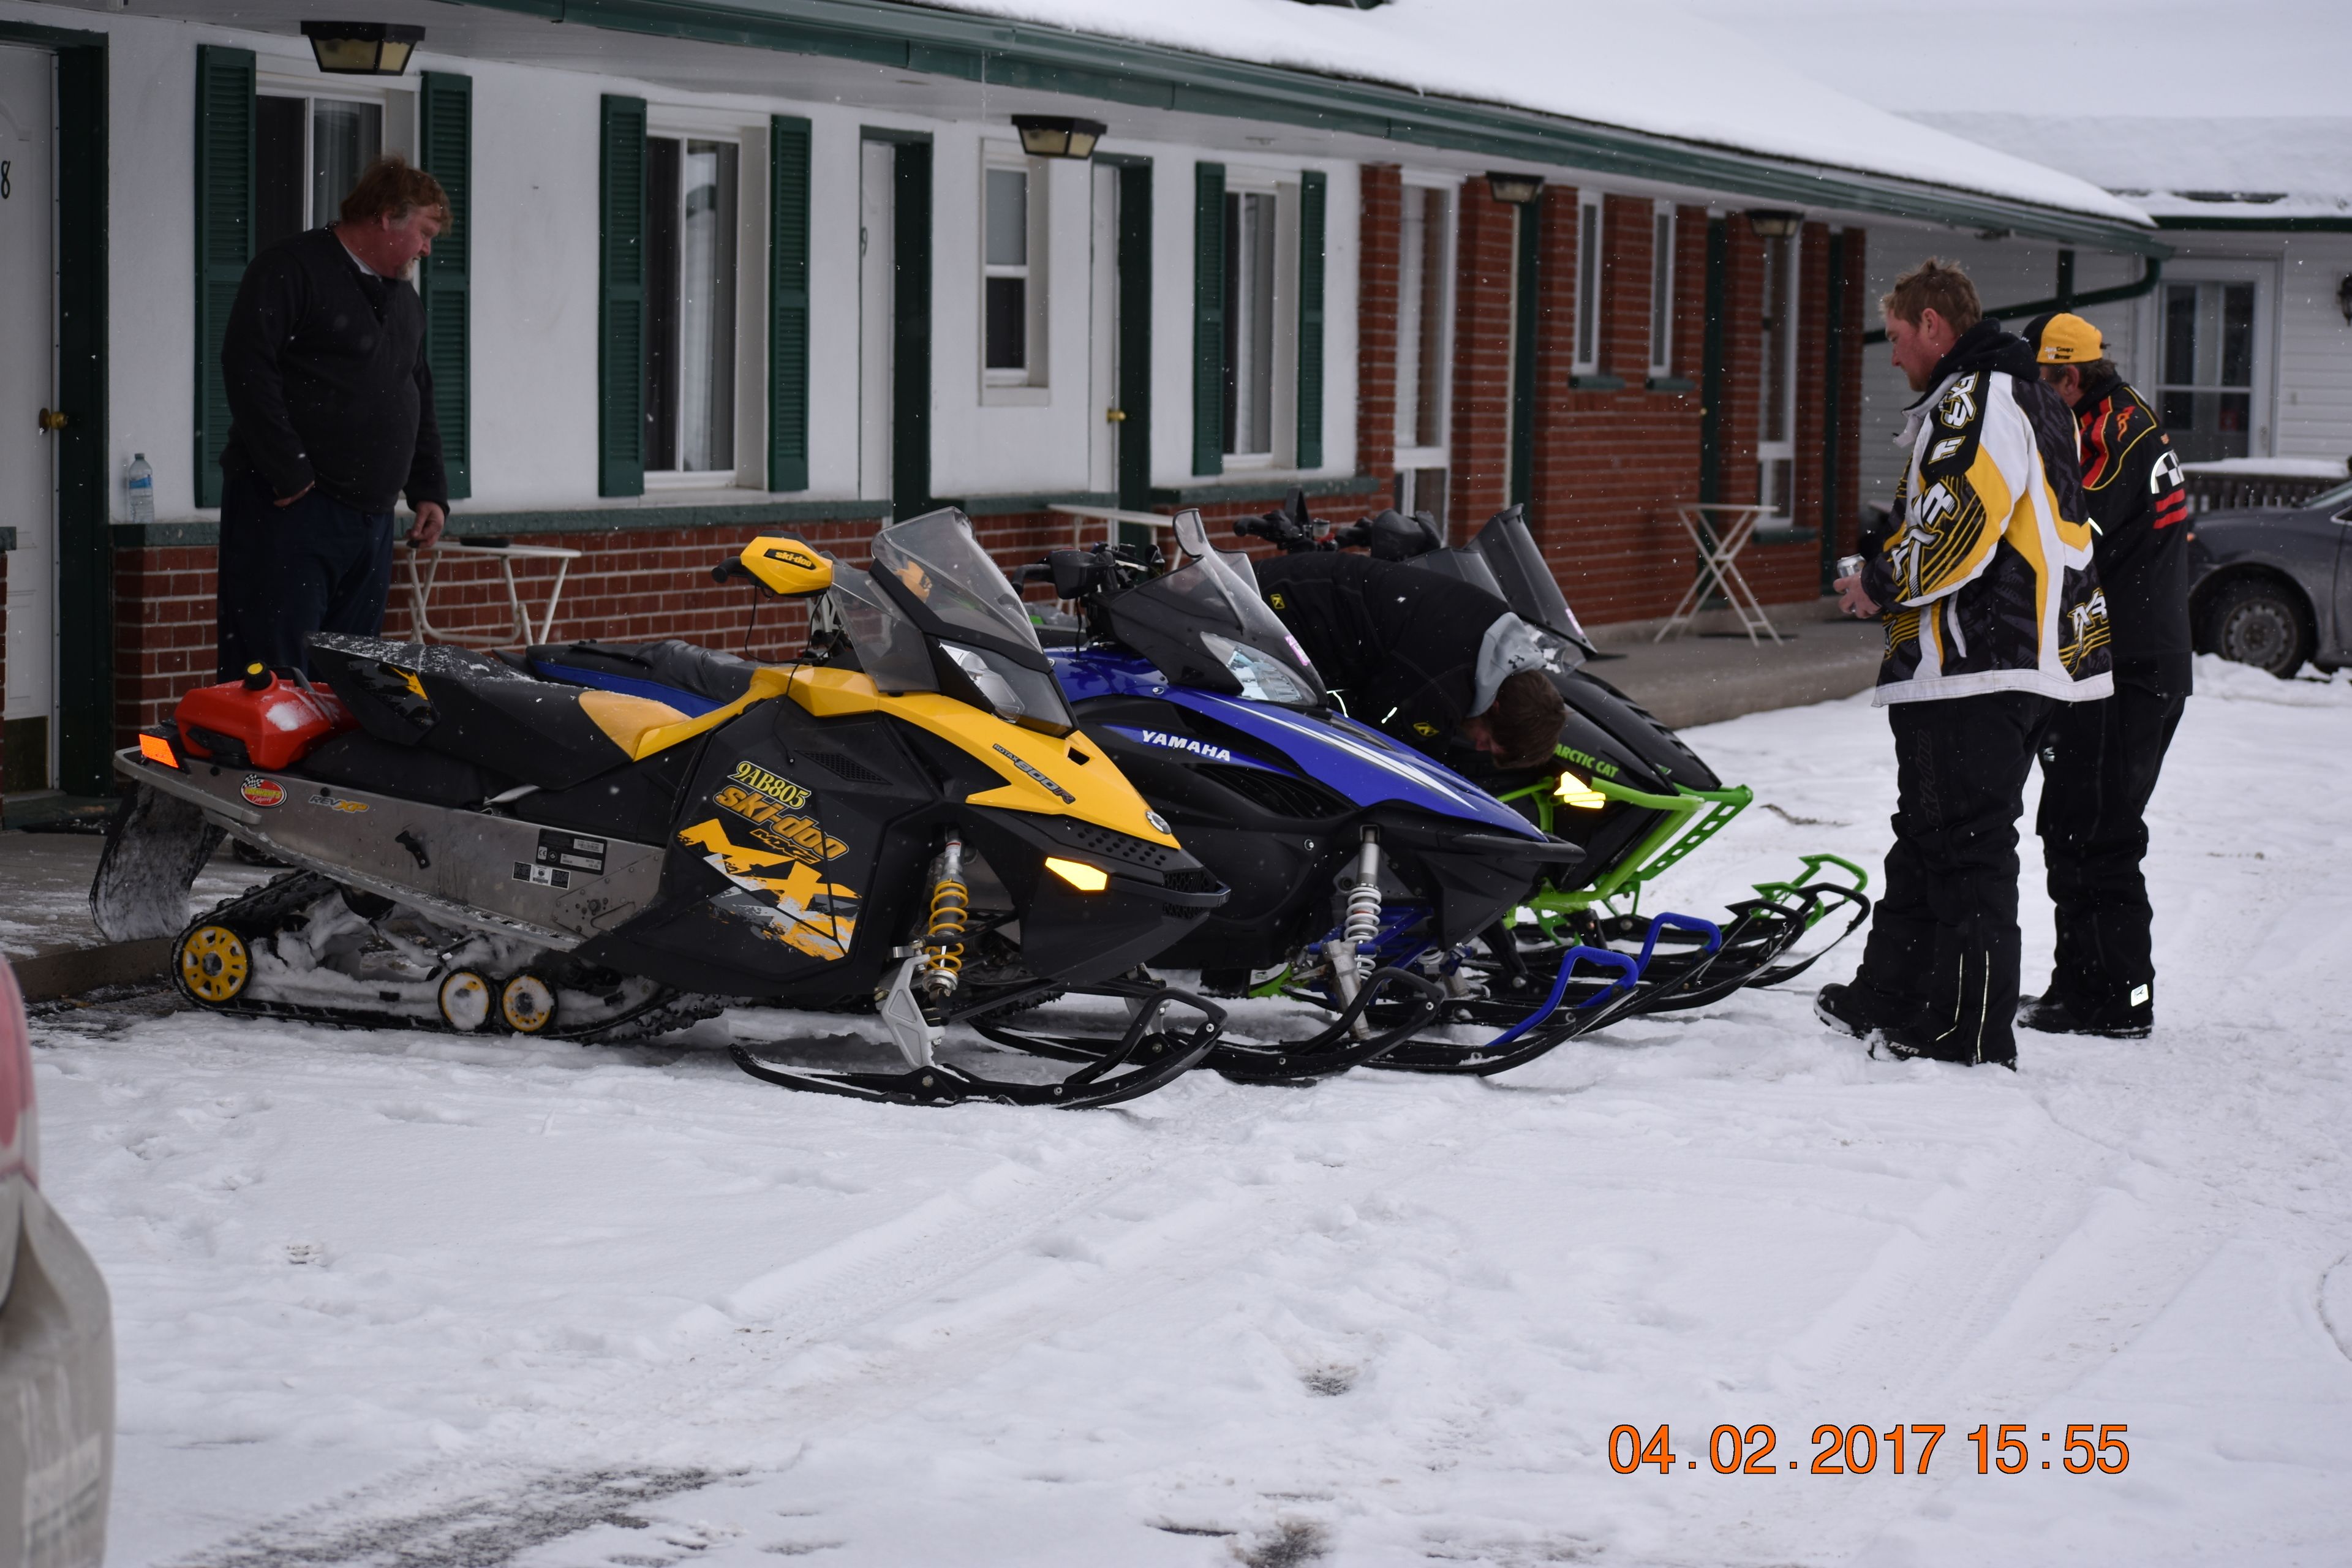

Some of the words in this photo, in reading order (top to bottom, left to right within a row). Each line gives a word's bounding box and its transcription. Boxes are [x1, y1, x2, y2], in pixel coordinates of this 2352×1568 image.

[1, 160, 10, 199] 8
[1142, 729, 1231, 761] YAMAHA
[1554, 743, 1596, 769] ARCTIC
[1596, 761, 1619, 778] CAT
[737, 761, 810, 808] 9AB805
[993, 743, 1018, 761] ROTAX
[1014, 759, 1076, 804] 800R
[750, 828, 821, 864] MXZ
[1889, 1041, 1920, 1054] FXR
